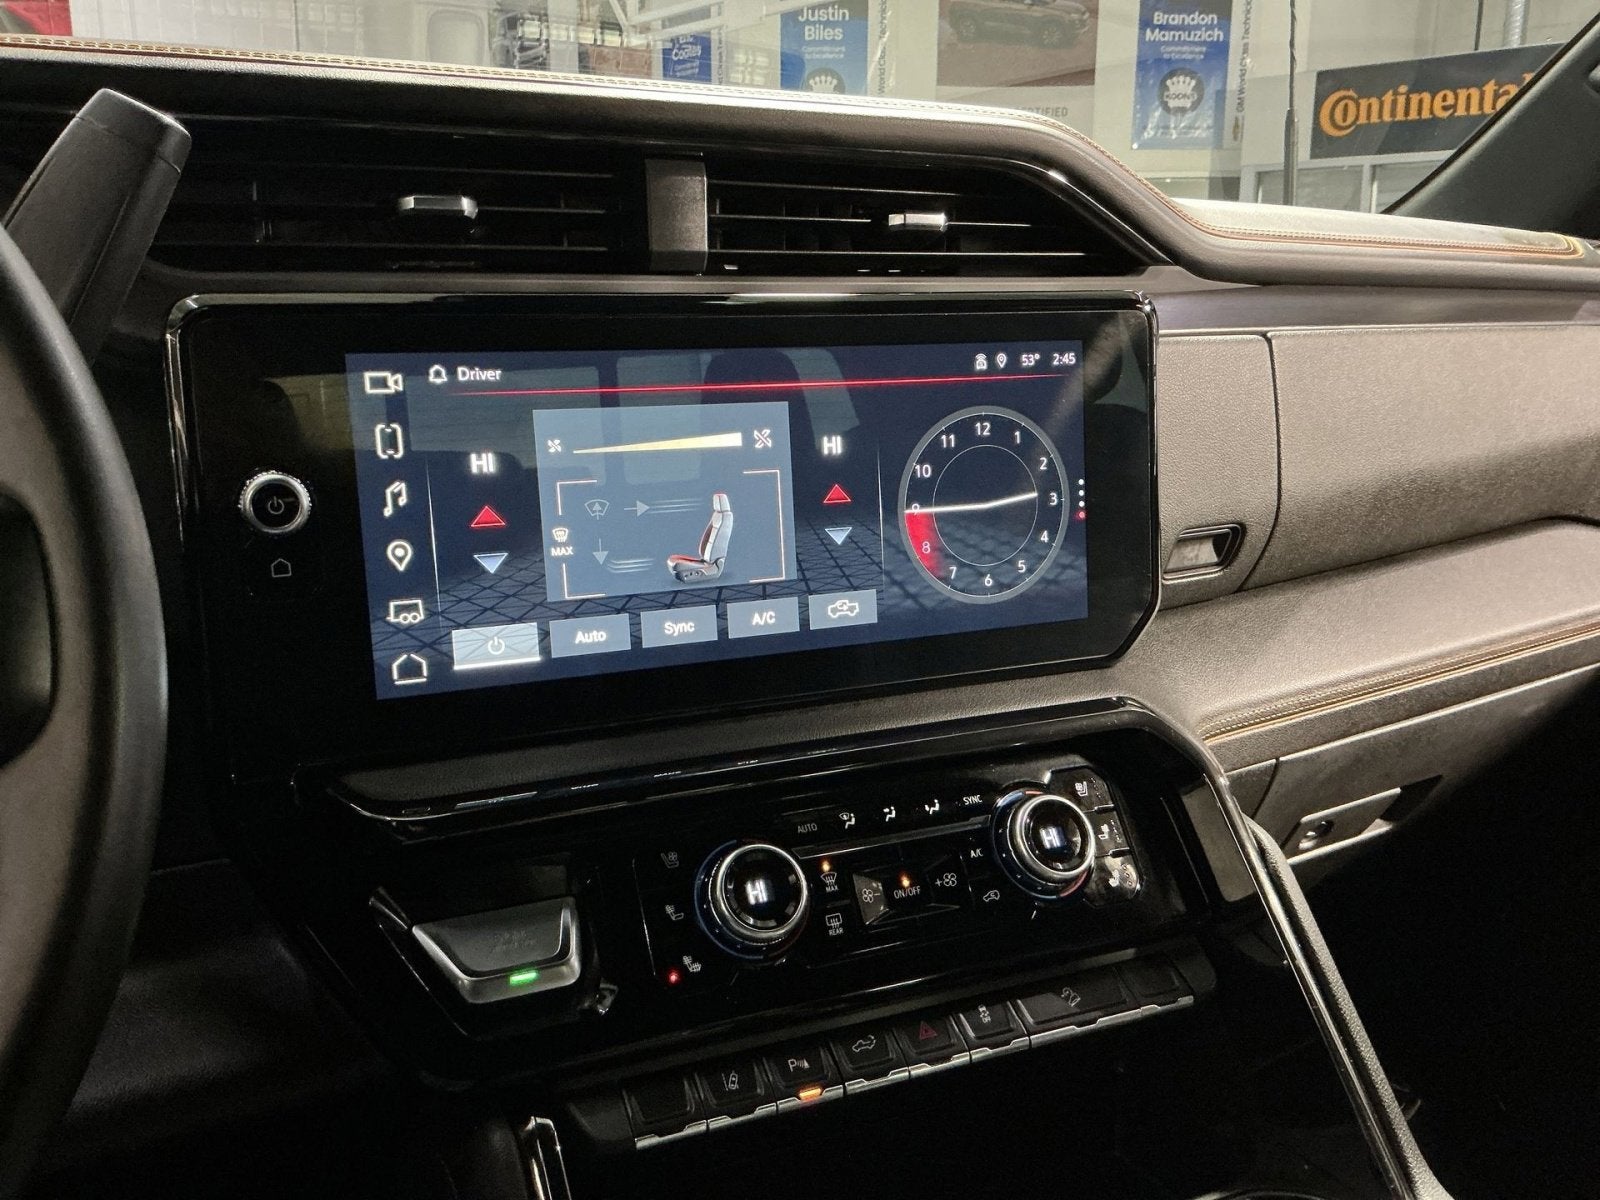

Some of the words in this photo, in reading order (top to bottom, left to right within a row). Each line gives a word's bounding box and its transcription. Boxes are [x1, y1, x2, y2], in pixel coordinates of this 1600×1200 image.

[798, 5, 849, 22] Justin
[1153, 11, 1218, 26] Brandon
[804, 26, 844, 41] Biles
[1145, 28, 1224, 43] Mamuzich
[878, 43, 886, 67] Clas
[877, 68, 886, 95] World
[1237, 69, 1247, 96] World
[1319, 73, 1535, 138] Continenta
[1021, 353, 1041, 366] 53°
[1052, 352, 1077, 366] 2:45
[457, 366, 503, 383] Driver
[974, 422, 991, 436] 12
[941, 434, 956, 448] 11
[1014, 430, 1021, 444] 1
[822, 436, 844, 456] HI
[470, 452, 497, 474] HI
[1039, 457, 1048, 470] 2
[914, 464, 932, 478] 10
[1049, 492, 1058, 506] 3
[911, 502, 921, 516] 9
[1040, 530, 1050, 543] 4
[550, 545, 574, 558] MAX
[921, 541, 931, 554] 8
[949, 566, 958, 580] 7
[1017, 560, 1027, 573] 5
[984, 574, 994, 587] 6
[752, 610, 776, 626] A/C
[664, 619, 696, 637] Sync
[574, 628, 608, 644] Auto
[963, 794, 983, 806] SYNC
[797, 822, 818, 834] AUTO
[1040, 825, 1062, 849] HI
[970, 848, 984, 858] A/C
[745, 877, 769, 906] HI
[825, 884, 839, 892] MAX
[893, 885, 921, 900] ON/OFF
[828, 927, 844, 937] REAR
